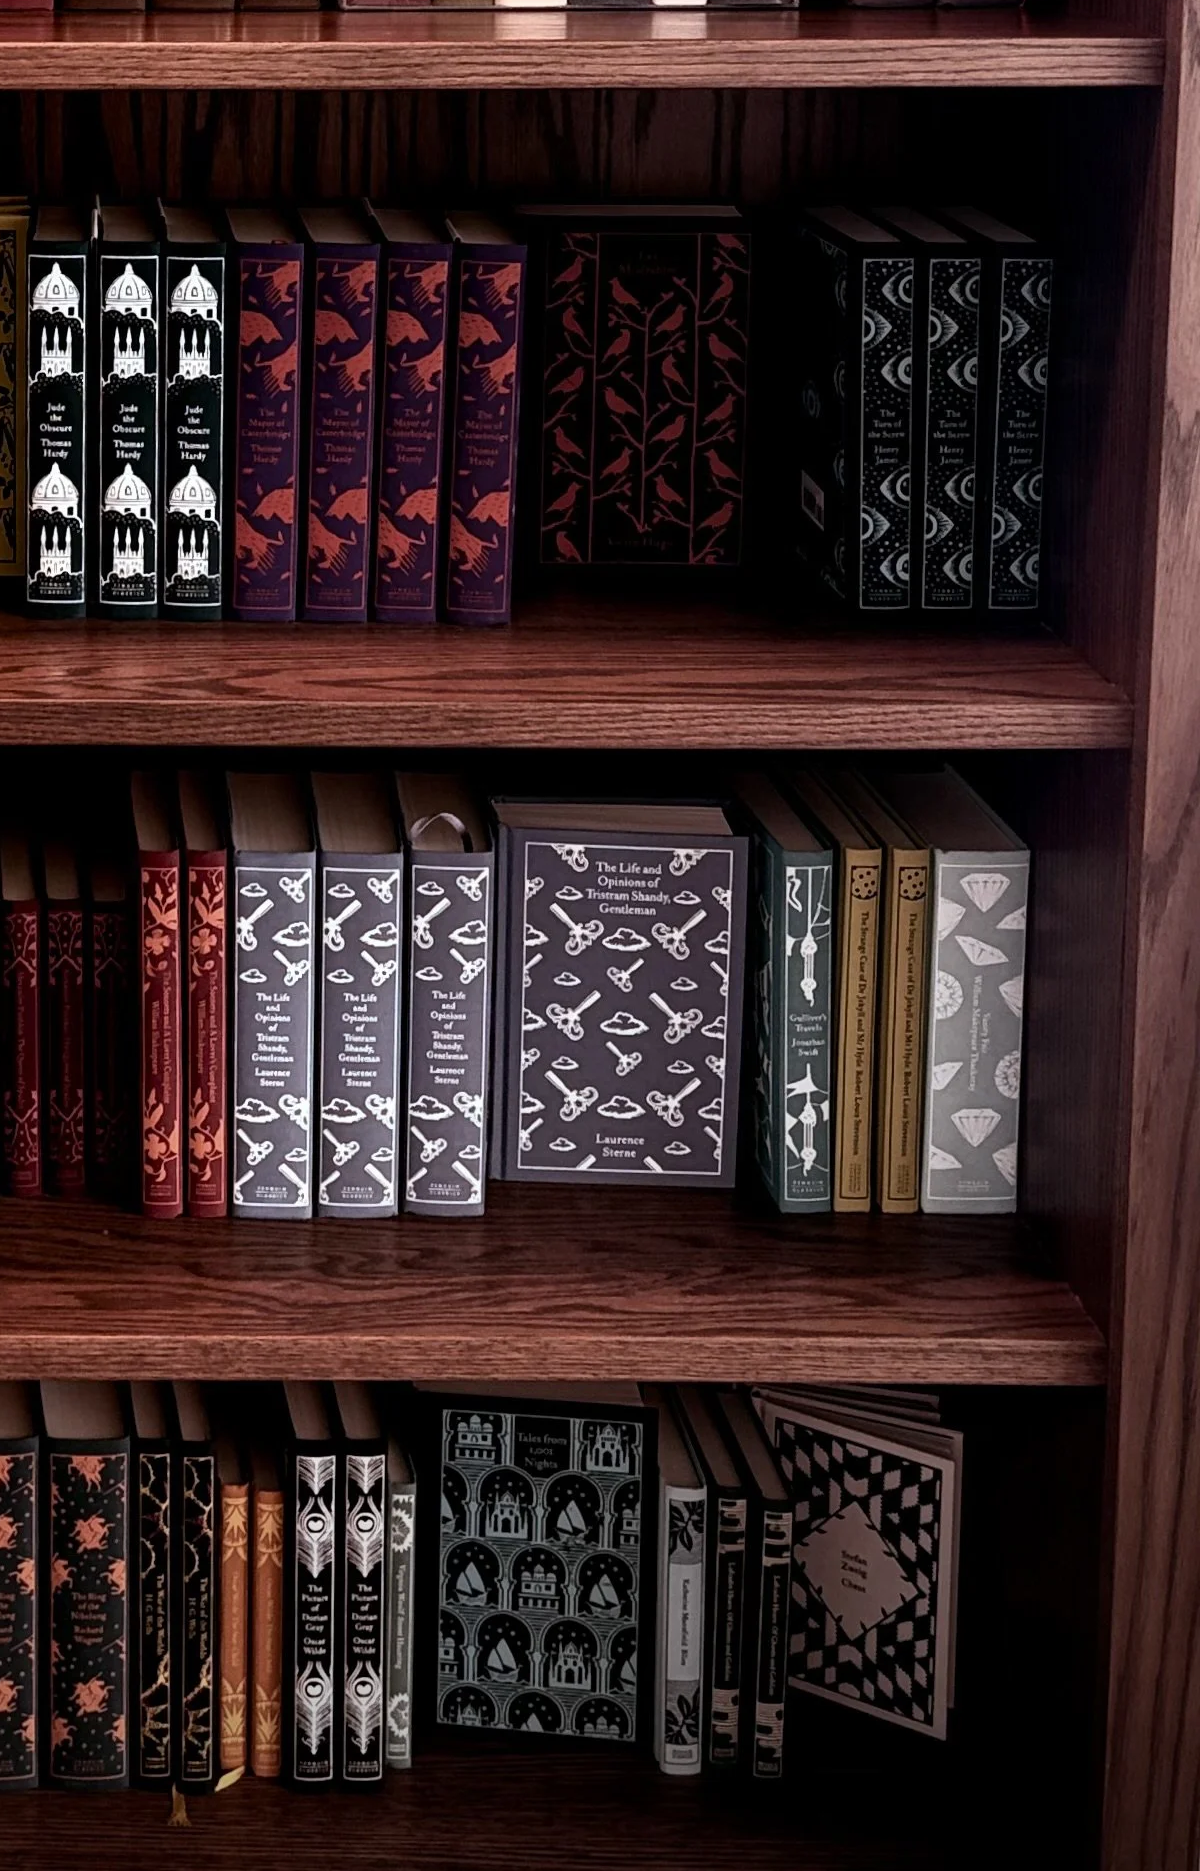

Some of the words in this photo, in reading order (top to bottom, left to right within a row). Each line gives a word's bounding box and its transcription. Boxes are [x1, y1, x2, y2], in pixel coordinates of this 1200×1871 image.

[46, 402, 65, 412] Jude
[185, 405, 203, 415] Jude
[50, 413, 62, 421] the
[40, 423, 72, 432] Obscure
[177, 426, 210, 435] Obscure
[41, 439, 71, 448] Thomas
[178, 441, 209, 450] Thomas
[44, 449, 68, 460] Hardy
[181, 451, 205, 462] Hardy
[596, 862, 615, 873] The
[620, 863, 640, 874] Life
[643, 865, 662, 875] and
[598, 876, 645, 889] Opinions
[648, 877, 660, 888] of
[586, 889, 627, 902] Tristram
[599, 904, 656, 916] Gentleman
[256, 993, 272, 1002] The
[274, 993, 290, 1002] Life
[255, 1013, 290, 1023] Opinions
[269, 1023, 278, 1031] of
[256, 1033, 289, 1043] Tristram
[252, 1053, 293, 1063] Gentleman
[255, 1068, 290, 1077] Laurence
[260, 1078, 284, 1087] Sterne
[596, 1134, 644, 1145] Laurence
[603, 1147, 636, 1158] Sterne
[517, 1432, 542, 1443] Tales
[544, 1435, 567, 1445] from
[524, 1457, 558, 1470] Nights
[308, 1585, 322, 1593] The
[302, 1594, 328, 1602] Picture
[302, 1613, 328, 1621] Dorian
[306, 1623, 324, 1632] Gray
[304, 1646, 326, 1654] Wilde
